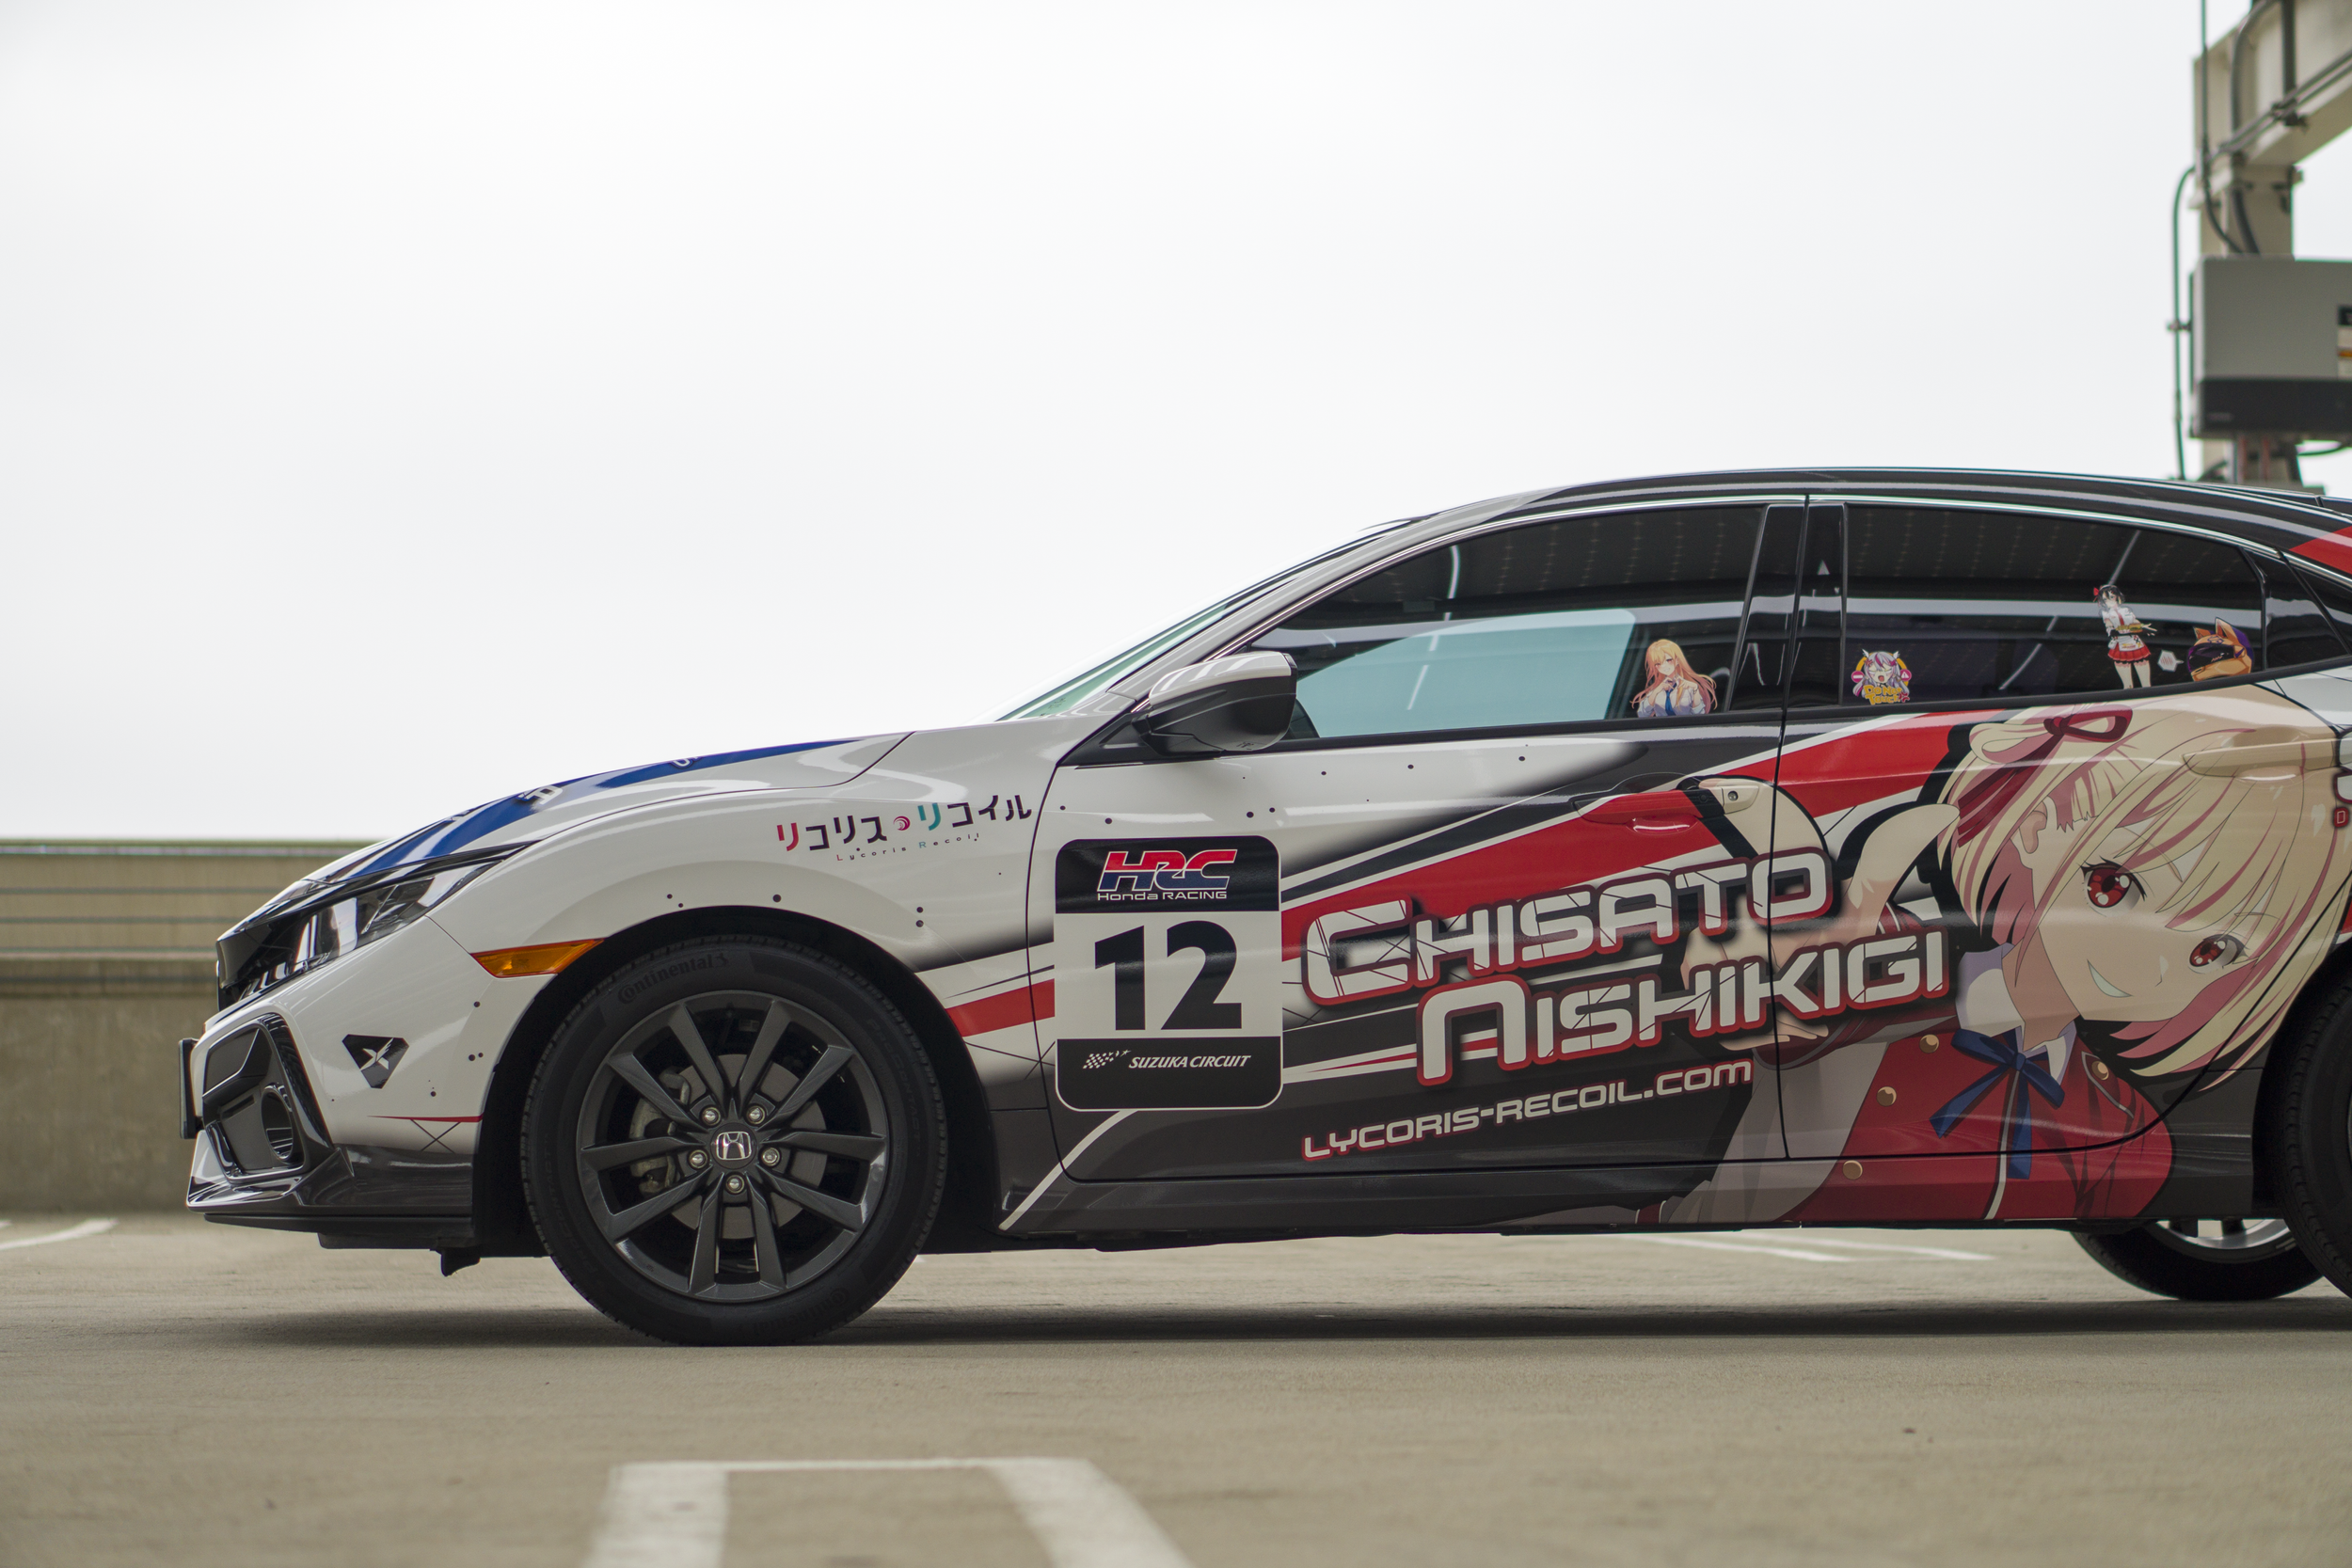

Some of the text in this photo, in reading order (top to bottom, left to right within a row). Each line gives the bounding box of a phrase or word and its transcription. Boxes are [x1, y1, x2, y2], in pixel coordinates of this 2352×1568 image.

[776, 795, 1032, 851] リコリス リコイル
[836, 832, 979, 862] Lycoris Recoil
[1097, 849, 1238, 892] HRC
[1097, 891, 1228, 901] Honda RACING
[617, 953, 715, 1005] Continental
[1094, 920, 1242, 1031] 12
[1128, 1054, 1252, 1069] SUZUKA CIRCUIT
